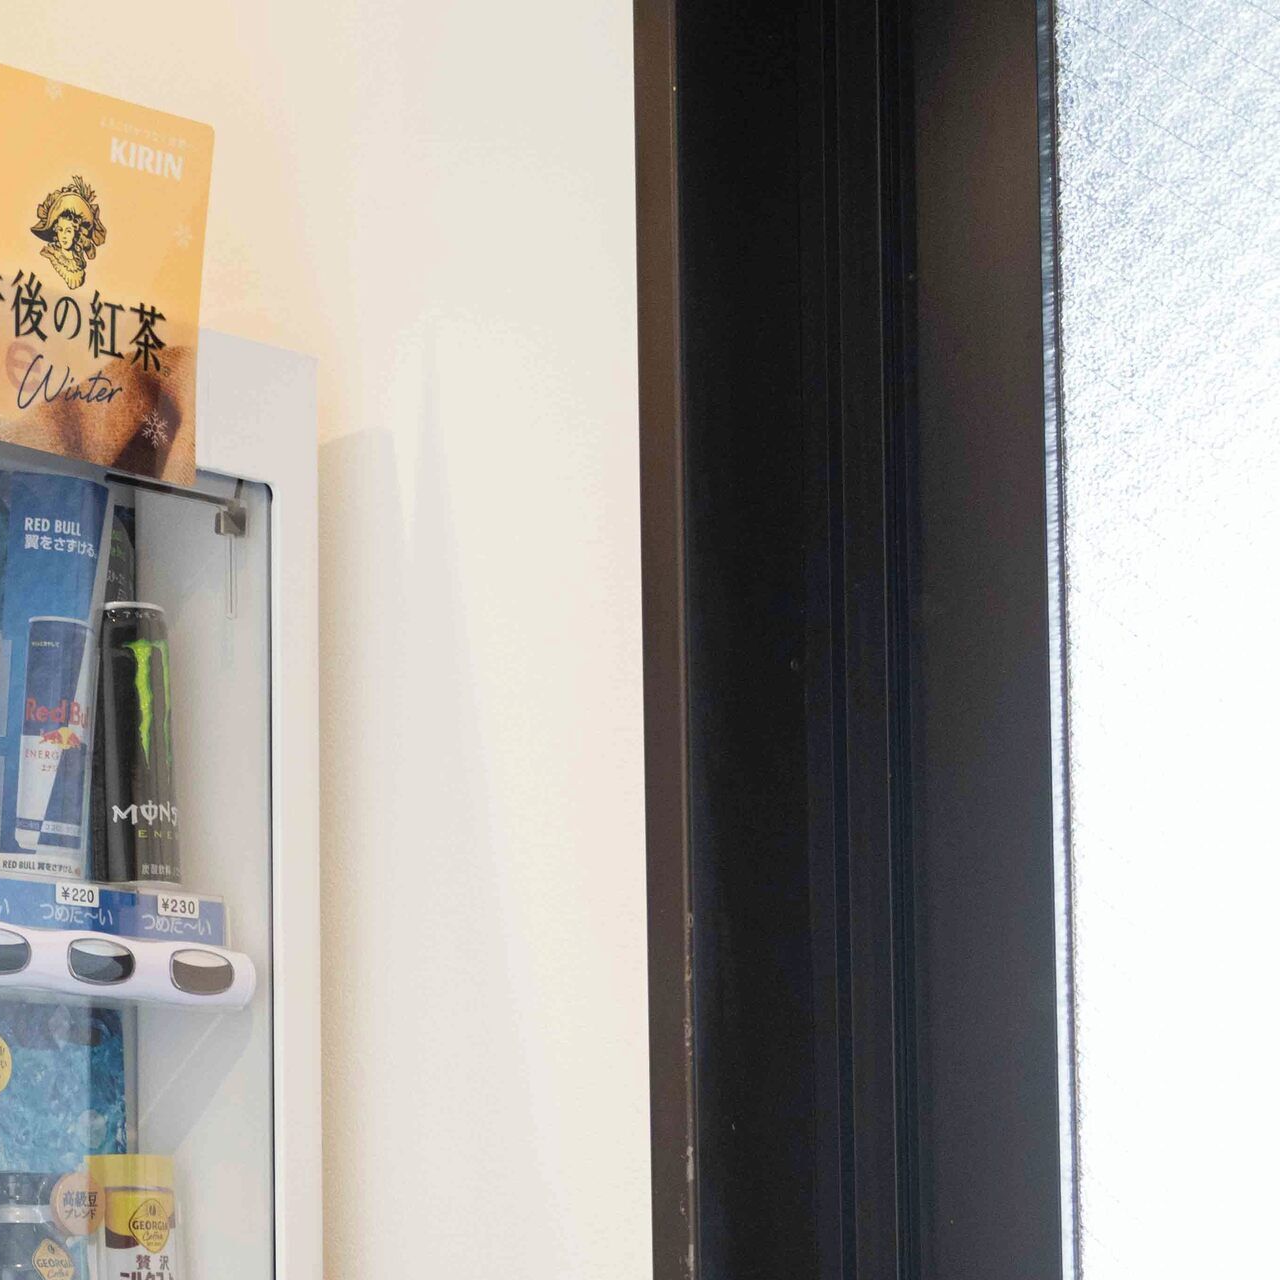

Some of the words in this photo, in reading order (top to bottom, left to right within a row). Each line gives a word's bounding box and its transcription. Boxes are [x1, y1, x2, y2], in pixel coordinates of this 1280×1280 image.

[110, 137, 183, 181] KIRIN
[17, 354, 124, 409] Winter
[24, 517, 51, 532] RED
[54, 519, 82, 537] BULL
[24, 535, 98, 559] 翼をさずける。
[26, 697, 67, 724] Red
[2, 859, 16, 870] RED
[18, 860, 37, 871] BULL
[60, 886, 95, 904] ¥220
[160, 898, 196, 916] ¥230
[62, 1191, 98, 1208] 高級豆
[64, 1208, 96, 1220] ブレンド
[136, 1255, 169, 1271] 贅沢
